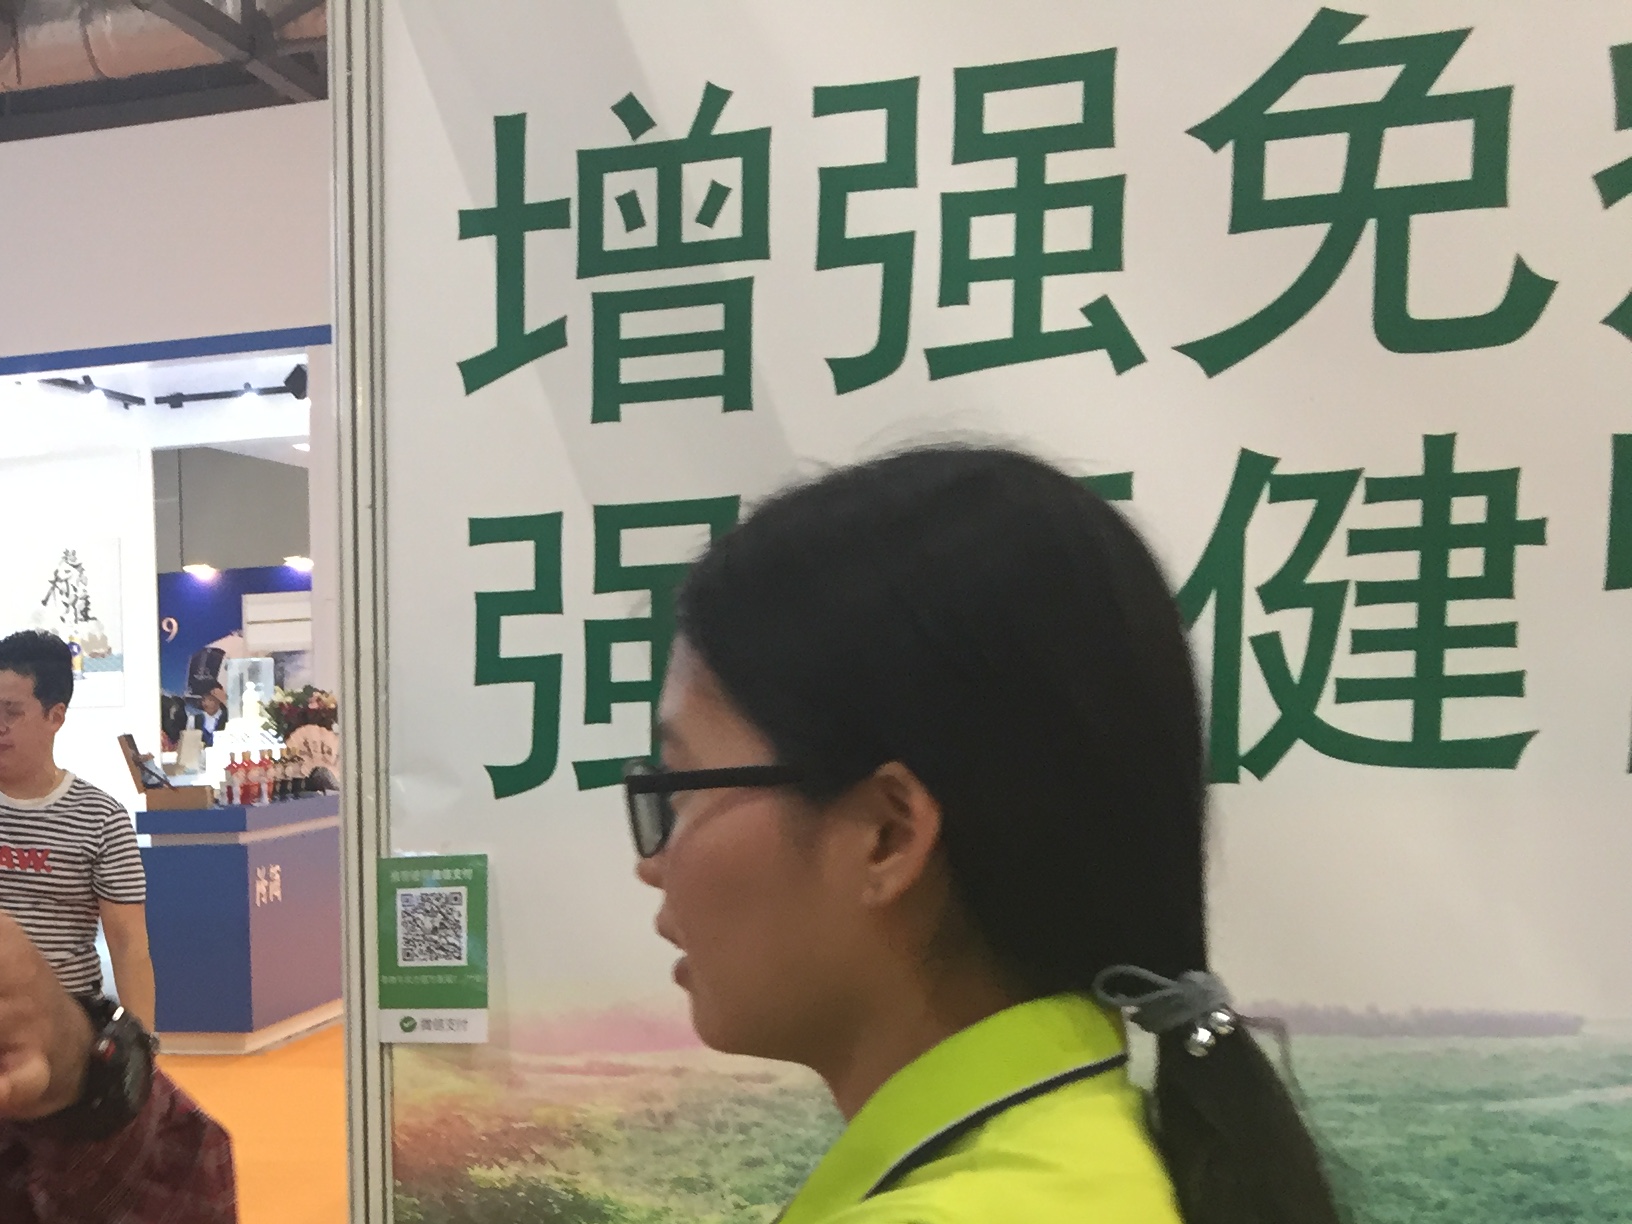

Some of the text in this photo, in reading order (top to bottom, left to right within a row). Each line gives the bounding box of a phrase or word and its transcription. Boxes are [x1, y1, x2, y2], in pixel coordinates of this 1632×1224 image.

[456, 5, 1632, 424] 增强免
[466, 432, 1632, 801] 强健
